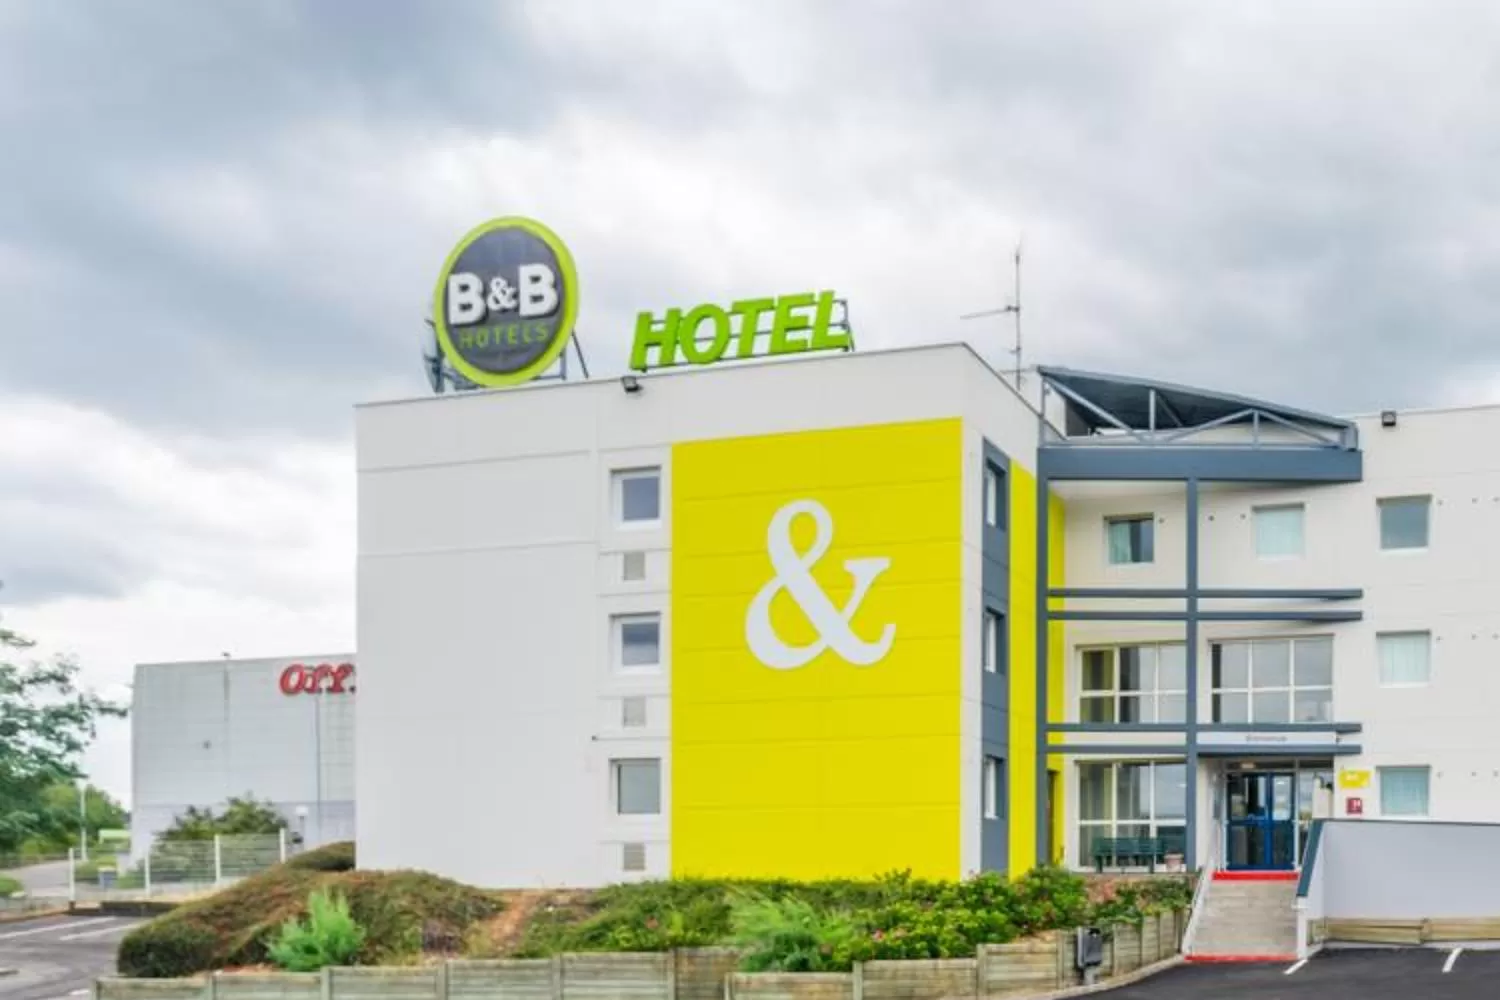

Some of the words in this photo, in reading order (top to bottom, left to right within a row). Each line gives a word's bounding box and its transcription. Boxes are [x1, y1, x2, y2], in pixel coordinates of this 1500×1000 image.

[447, 263, 558, 325] B&B
[459, 322, 550, 350] HOTELS
[629, 291, 849, 370] HOTEL
[745, 498, 896, 669] &
